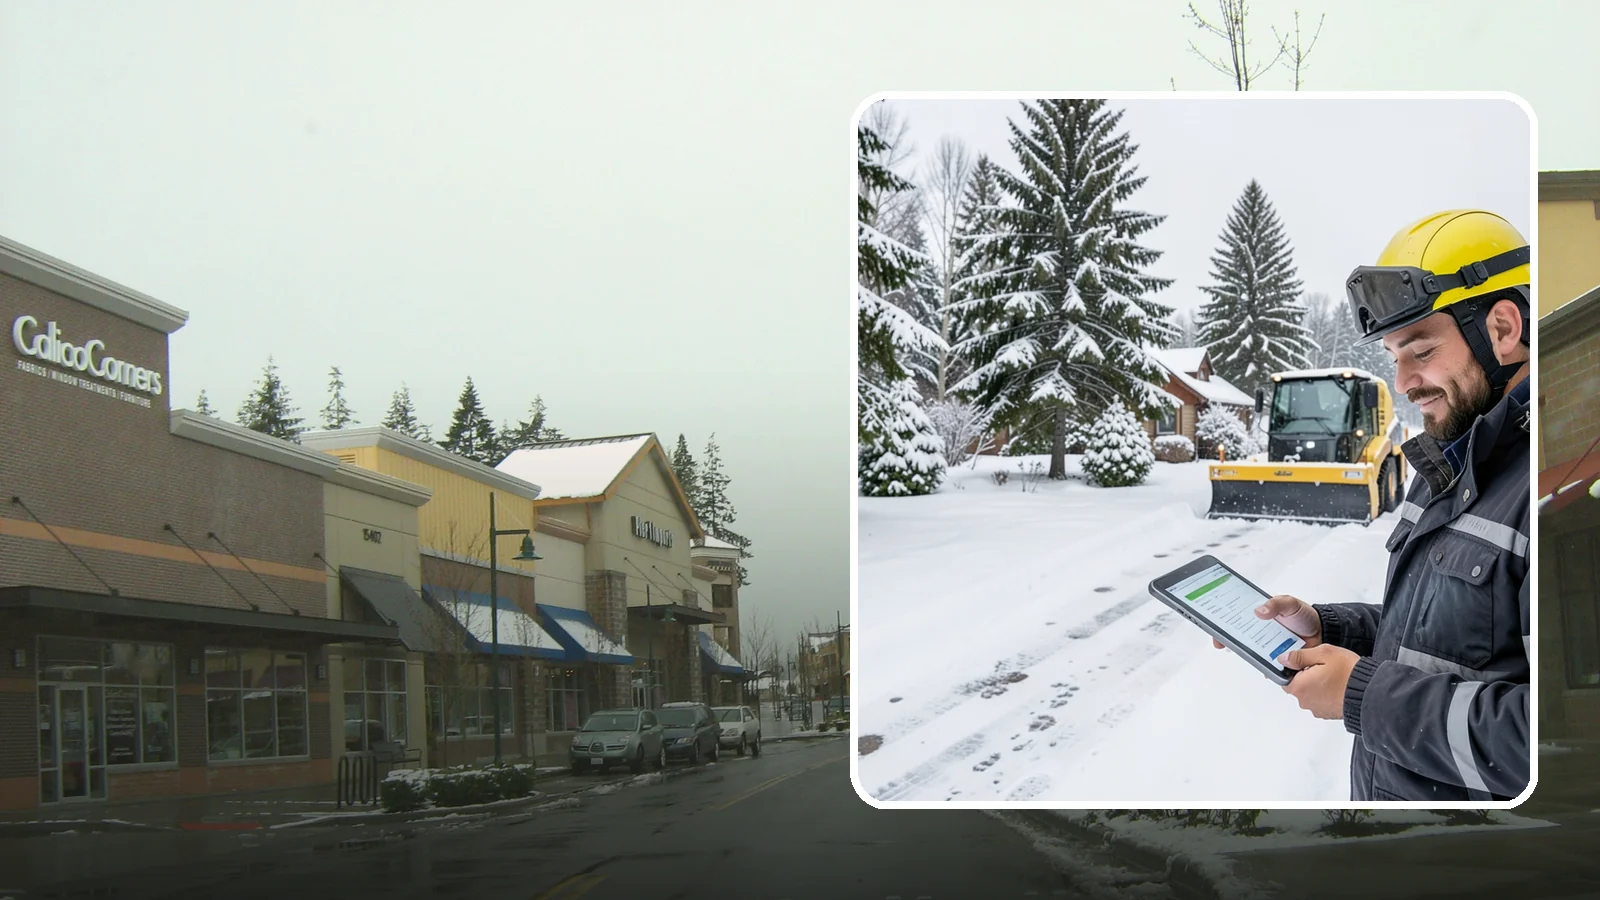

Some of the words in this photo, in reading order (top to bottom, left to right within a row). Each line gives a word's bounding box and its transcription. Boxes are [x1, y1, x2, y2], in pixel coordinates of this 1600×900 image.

[16, 360, 47, 378] FABRICS
[51, 370, 78, 386] WINDOW
[78, 378, 116, 398] TREATMENTS
[120, 391, 151, 408] FURNITURE
